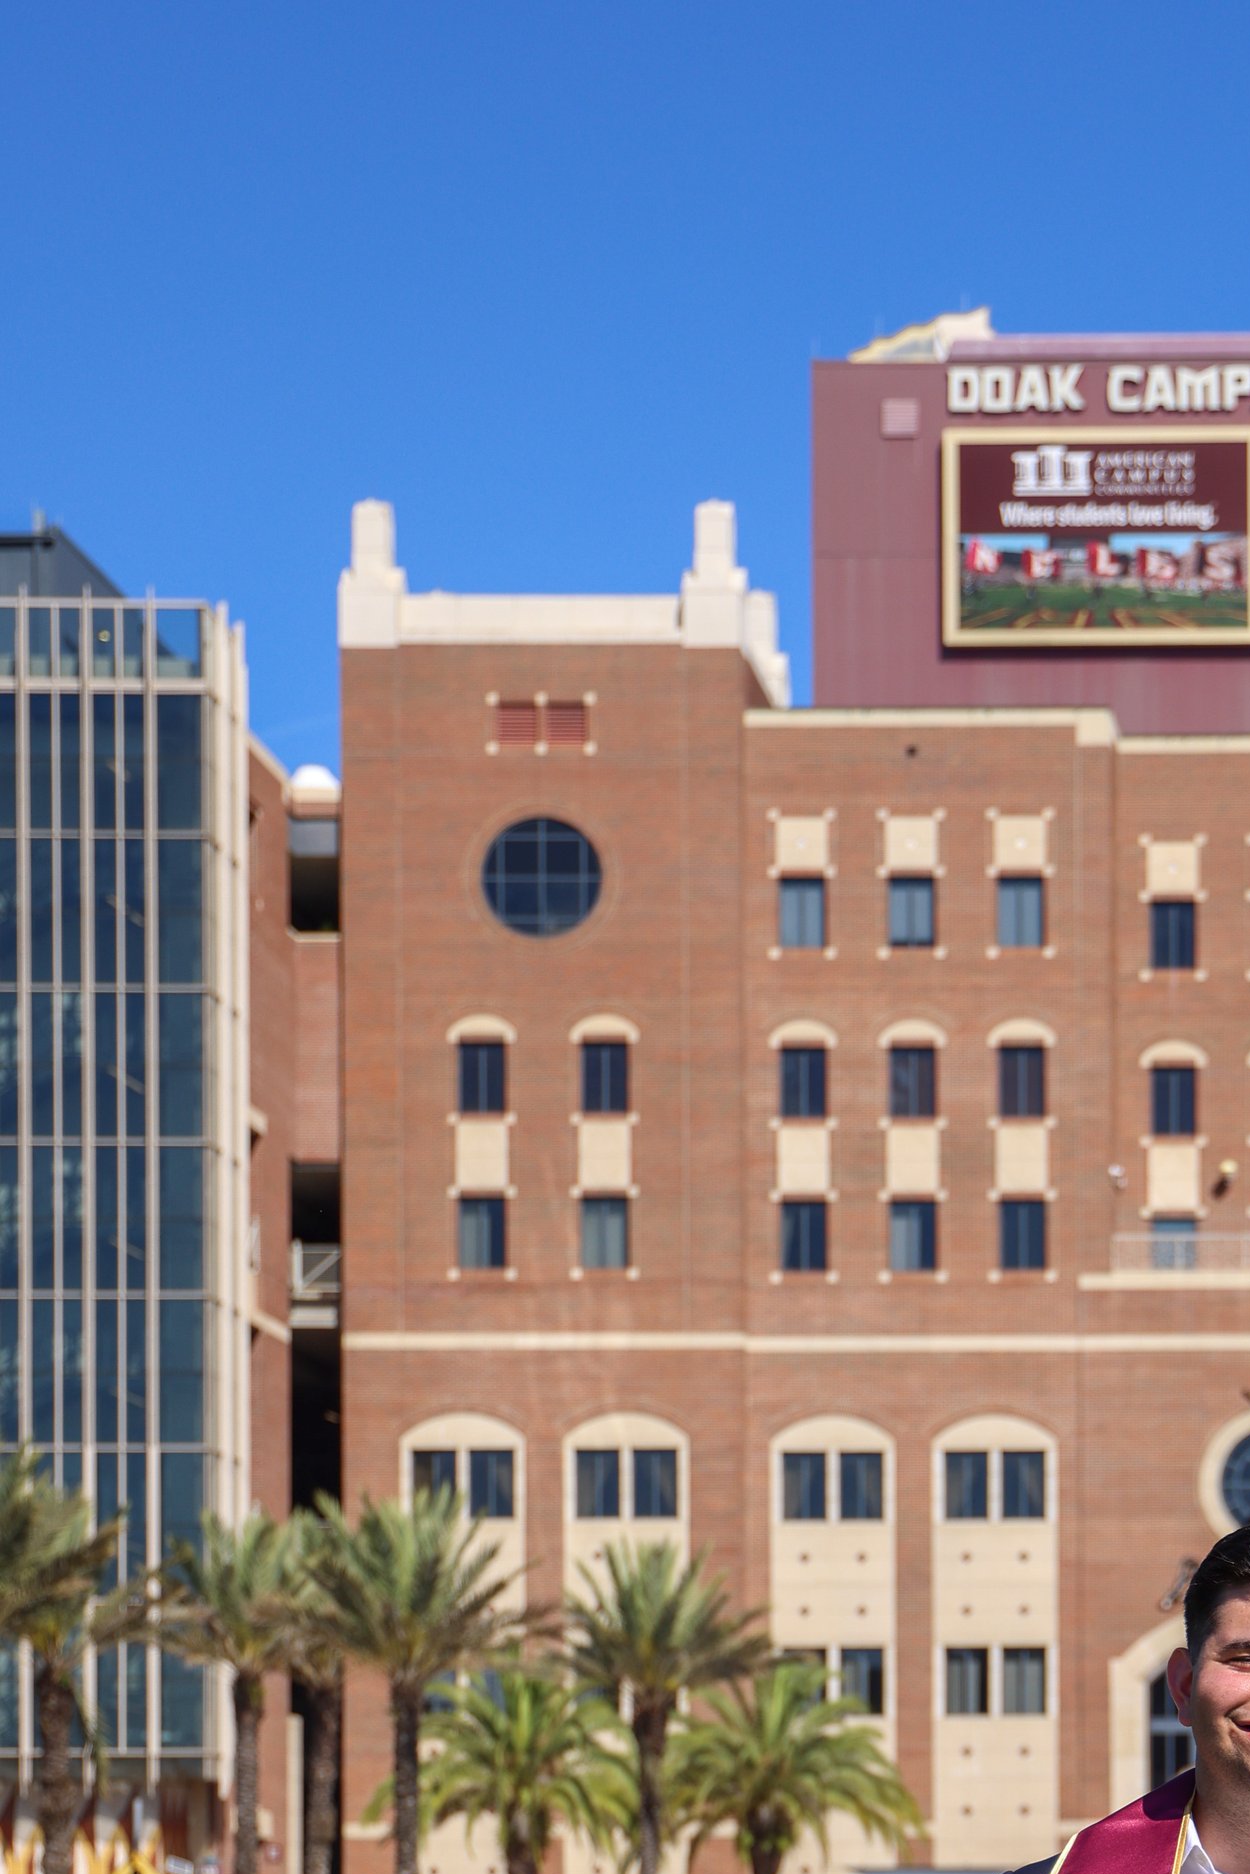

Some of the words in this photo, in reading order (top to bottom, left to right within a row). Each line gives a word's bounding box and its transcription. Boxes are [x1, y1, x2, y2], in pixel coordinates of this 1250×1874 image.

[947, 364, 1086, 414] DOAK
[1096, 450, 1196, 469] AMERICAN
[1094, 467, 1196, 485] CAMPUS
[1000, 501, 1056, 527] Where
[1056, 501, 1127, 527] students
[1128, 501, 1164, 527] love
